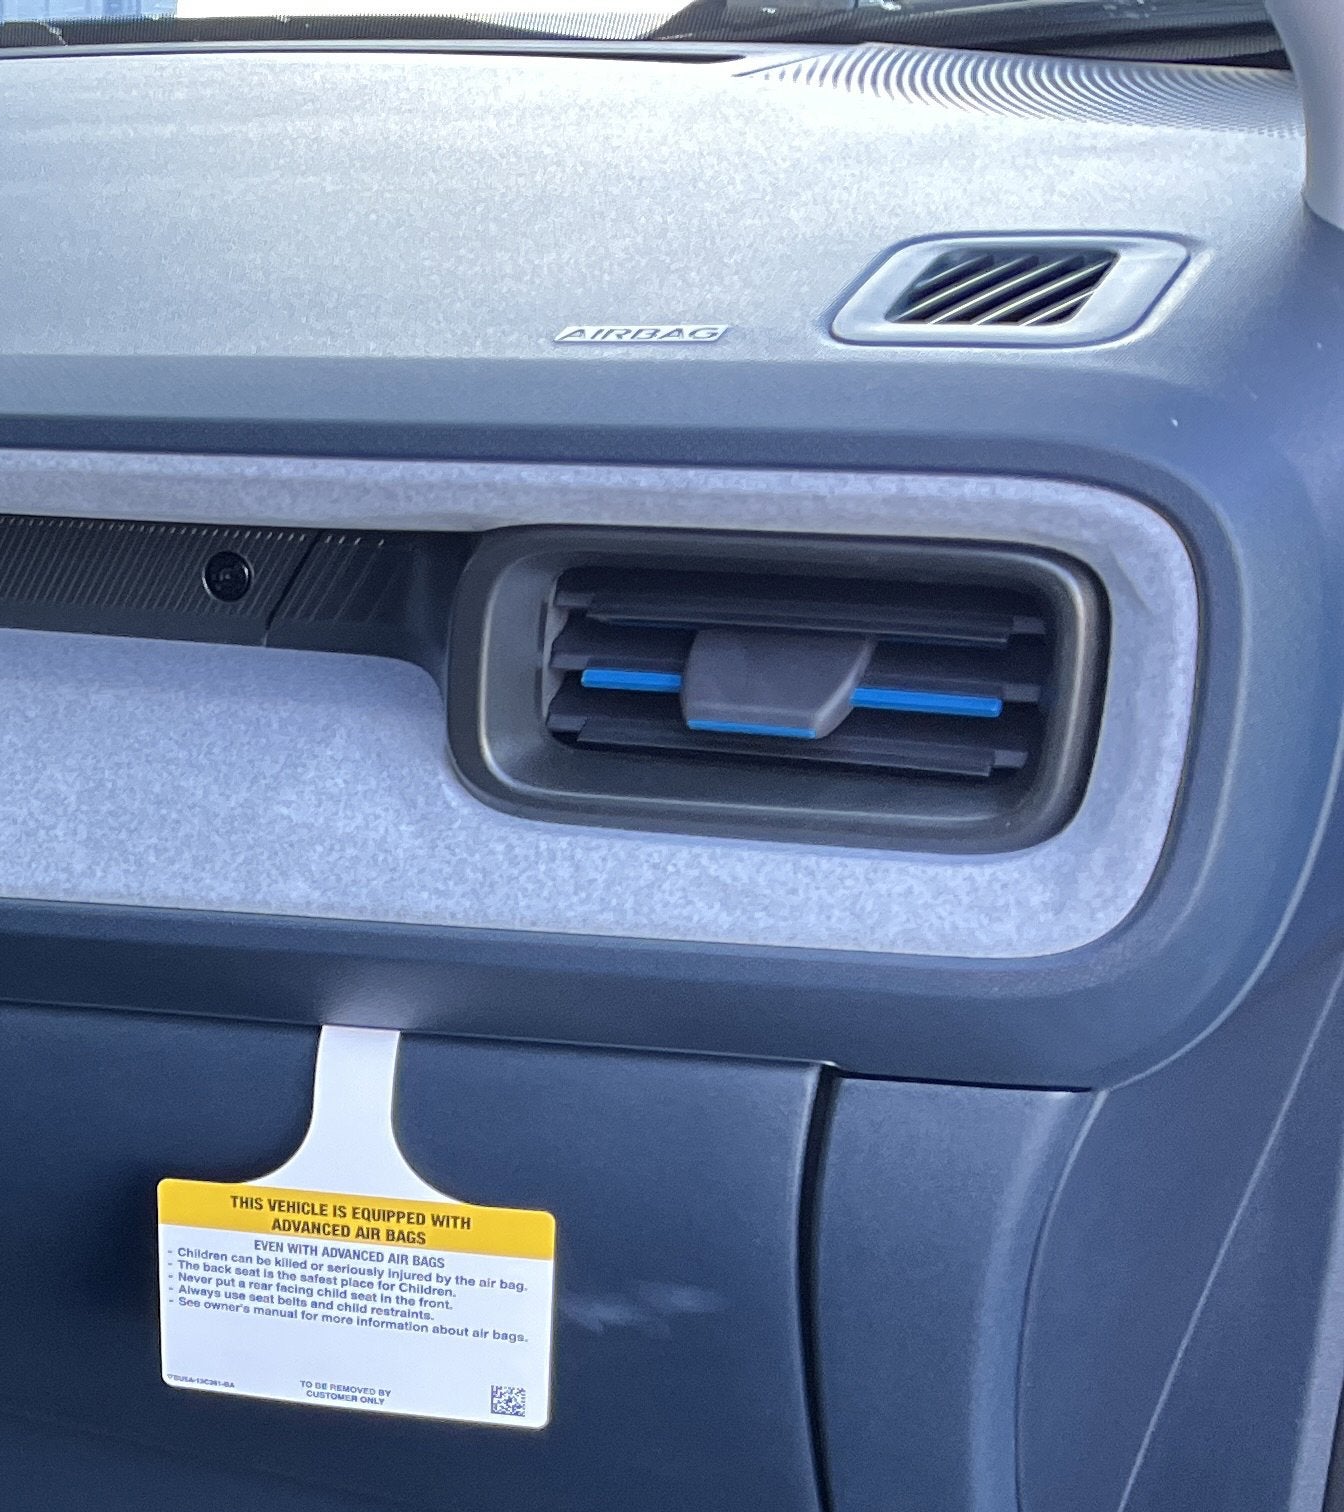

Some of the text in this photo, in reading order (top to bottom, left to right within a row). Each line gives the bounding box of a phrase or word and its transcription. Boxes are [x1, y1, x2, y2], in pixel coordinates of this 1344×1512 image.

[557, 326, 721, 341] AIRBAG
[230, 1195, 472, 1230] THIS VEHICLE IS EQUIPPED WITH
[271, 1218, 427, 1245] ADVANCED AIR BAGS
[177, 1247, 528, 1293] Children can be killed or seriously injured by the air bag.
[254, 1239, 445, 1269] EVEN WITH ADVANCED AIR BAGS
[177, 1260, 456, 1298] The back seat is the safest place for Children.
[178, 1272, 453, 1310] Never put a rear facing child seat in the front.
[178, 1284, 435, 1321] Always use seat belts and child restraints.
[178, 1296, 529, 1344] See owner's manual for more information about air bags.
[299, 1379, 391, 1398] TO BE REMOVED BY
[306, 1389, 385, 1406] CUSTOMER ONLY
